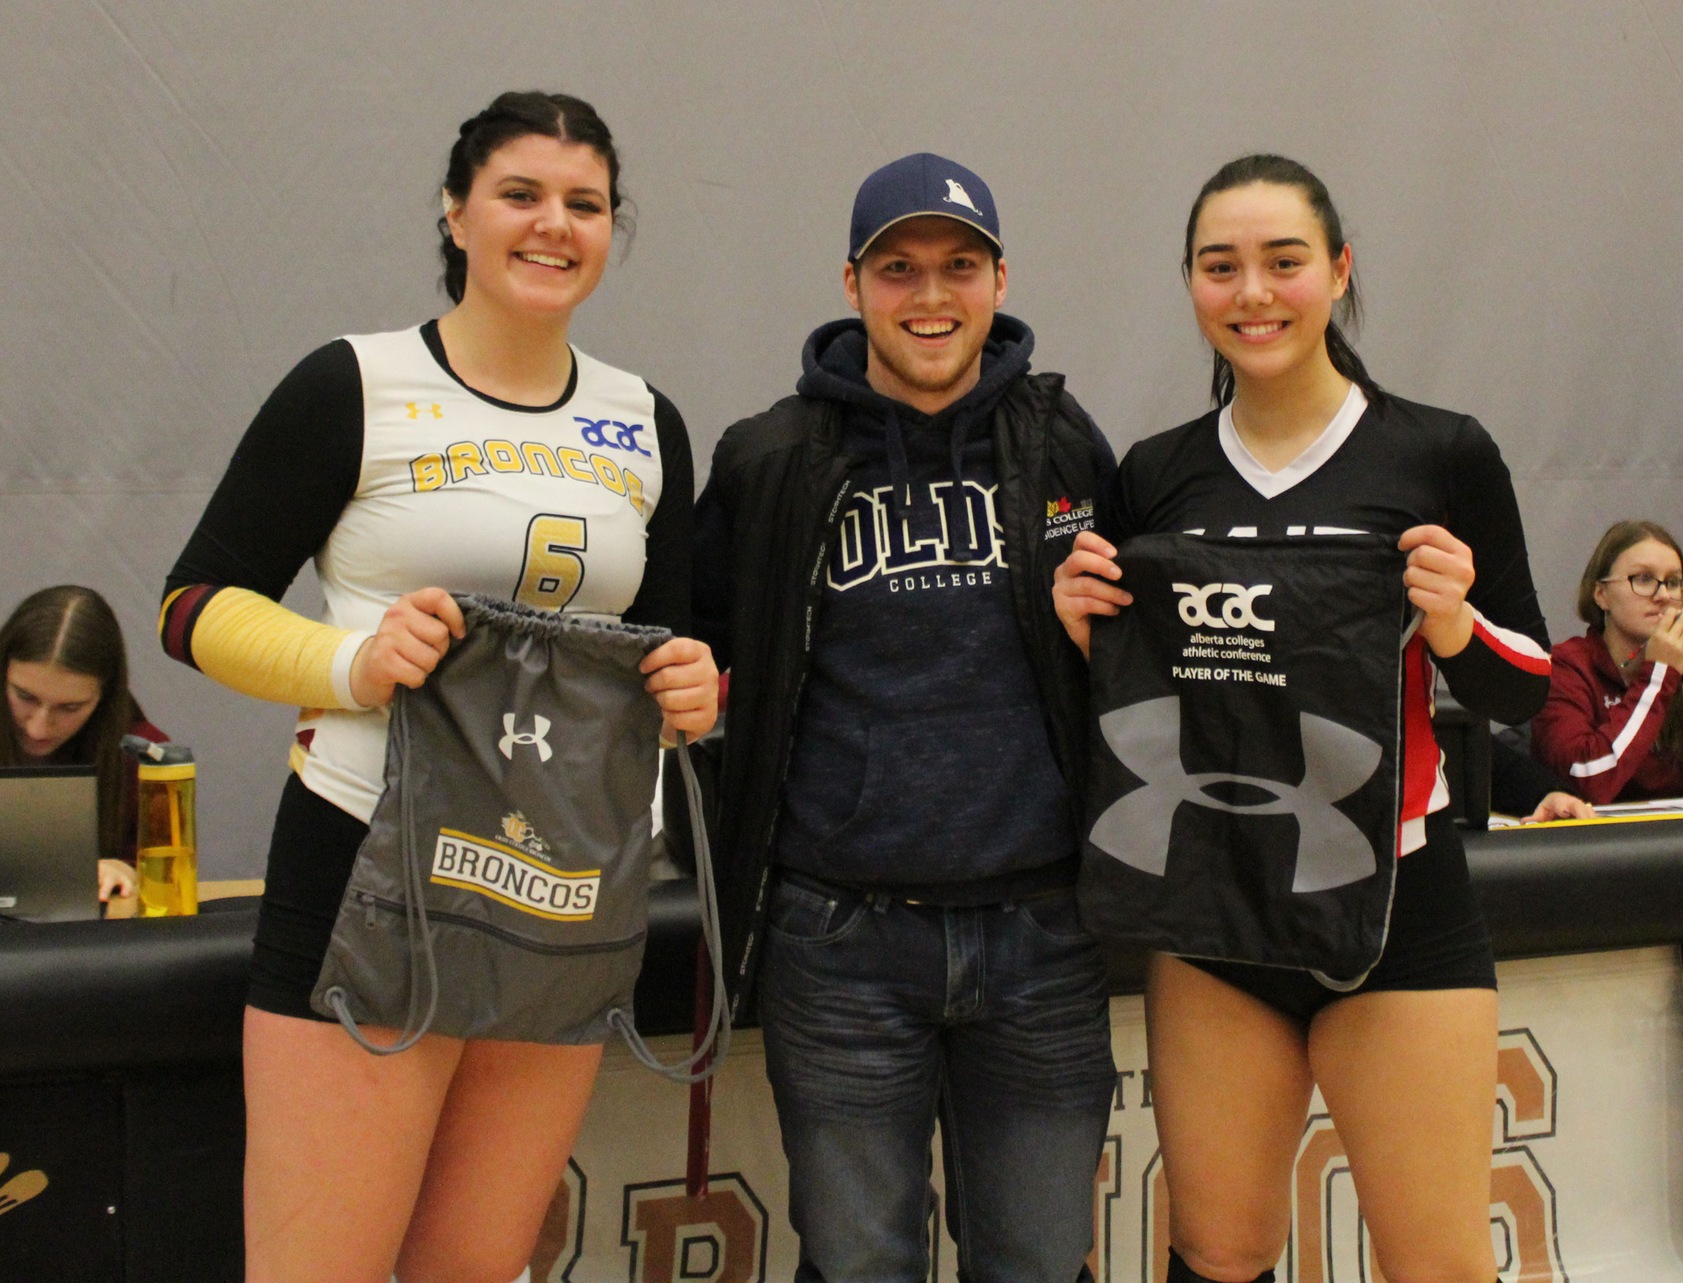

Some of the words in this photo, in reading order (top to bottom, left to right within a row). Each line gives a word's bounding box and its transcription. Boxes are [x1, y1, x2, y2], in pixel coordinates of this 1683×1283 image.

[409, 439, 645, 516] BRONCOS
[828, 479, 851, 523] STORMTECH
[1053, 508, 1094, 524] COLLEGE
[826, 480, 1009, 592] OLD
[1078, 518, 1095, 531] LIFE
[512, 512, 588, 613] 6
[889, 571, 993, 593] COLLEGE
[1171, 582, 1276, 632] acac
[1182, 646, 1220, 659] athletic
[1220, 648, 1271, 663] conference
[1190, 633, 1224, 646] alberta
[1225, 634, 1265, 650] colleges
[1172, 666, 1212, 681] PLAYER
[1213, 668, 1230, 681] OF
[1231, 669, 1254, 683] THE
[1255, 671, 1287, 687] GAME
[437, 841, 594, 910] BRONCOS
